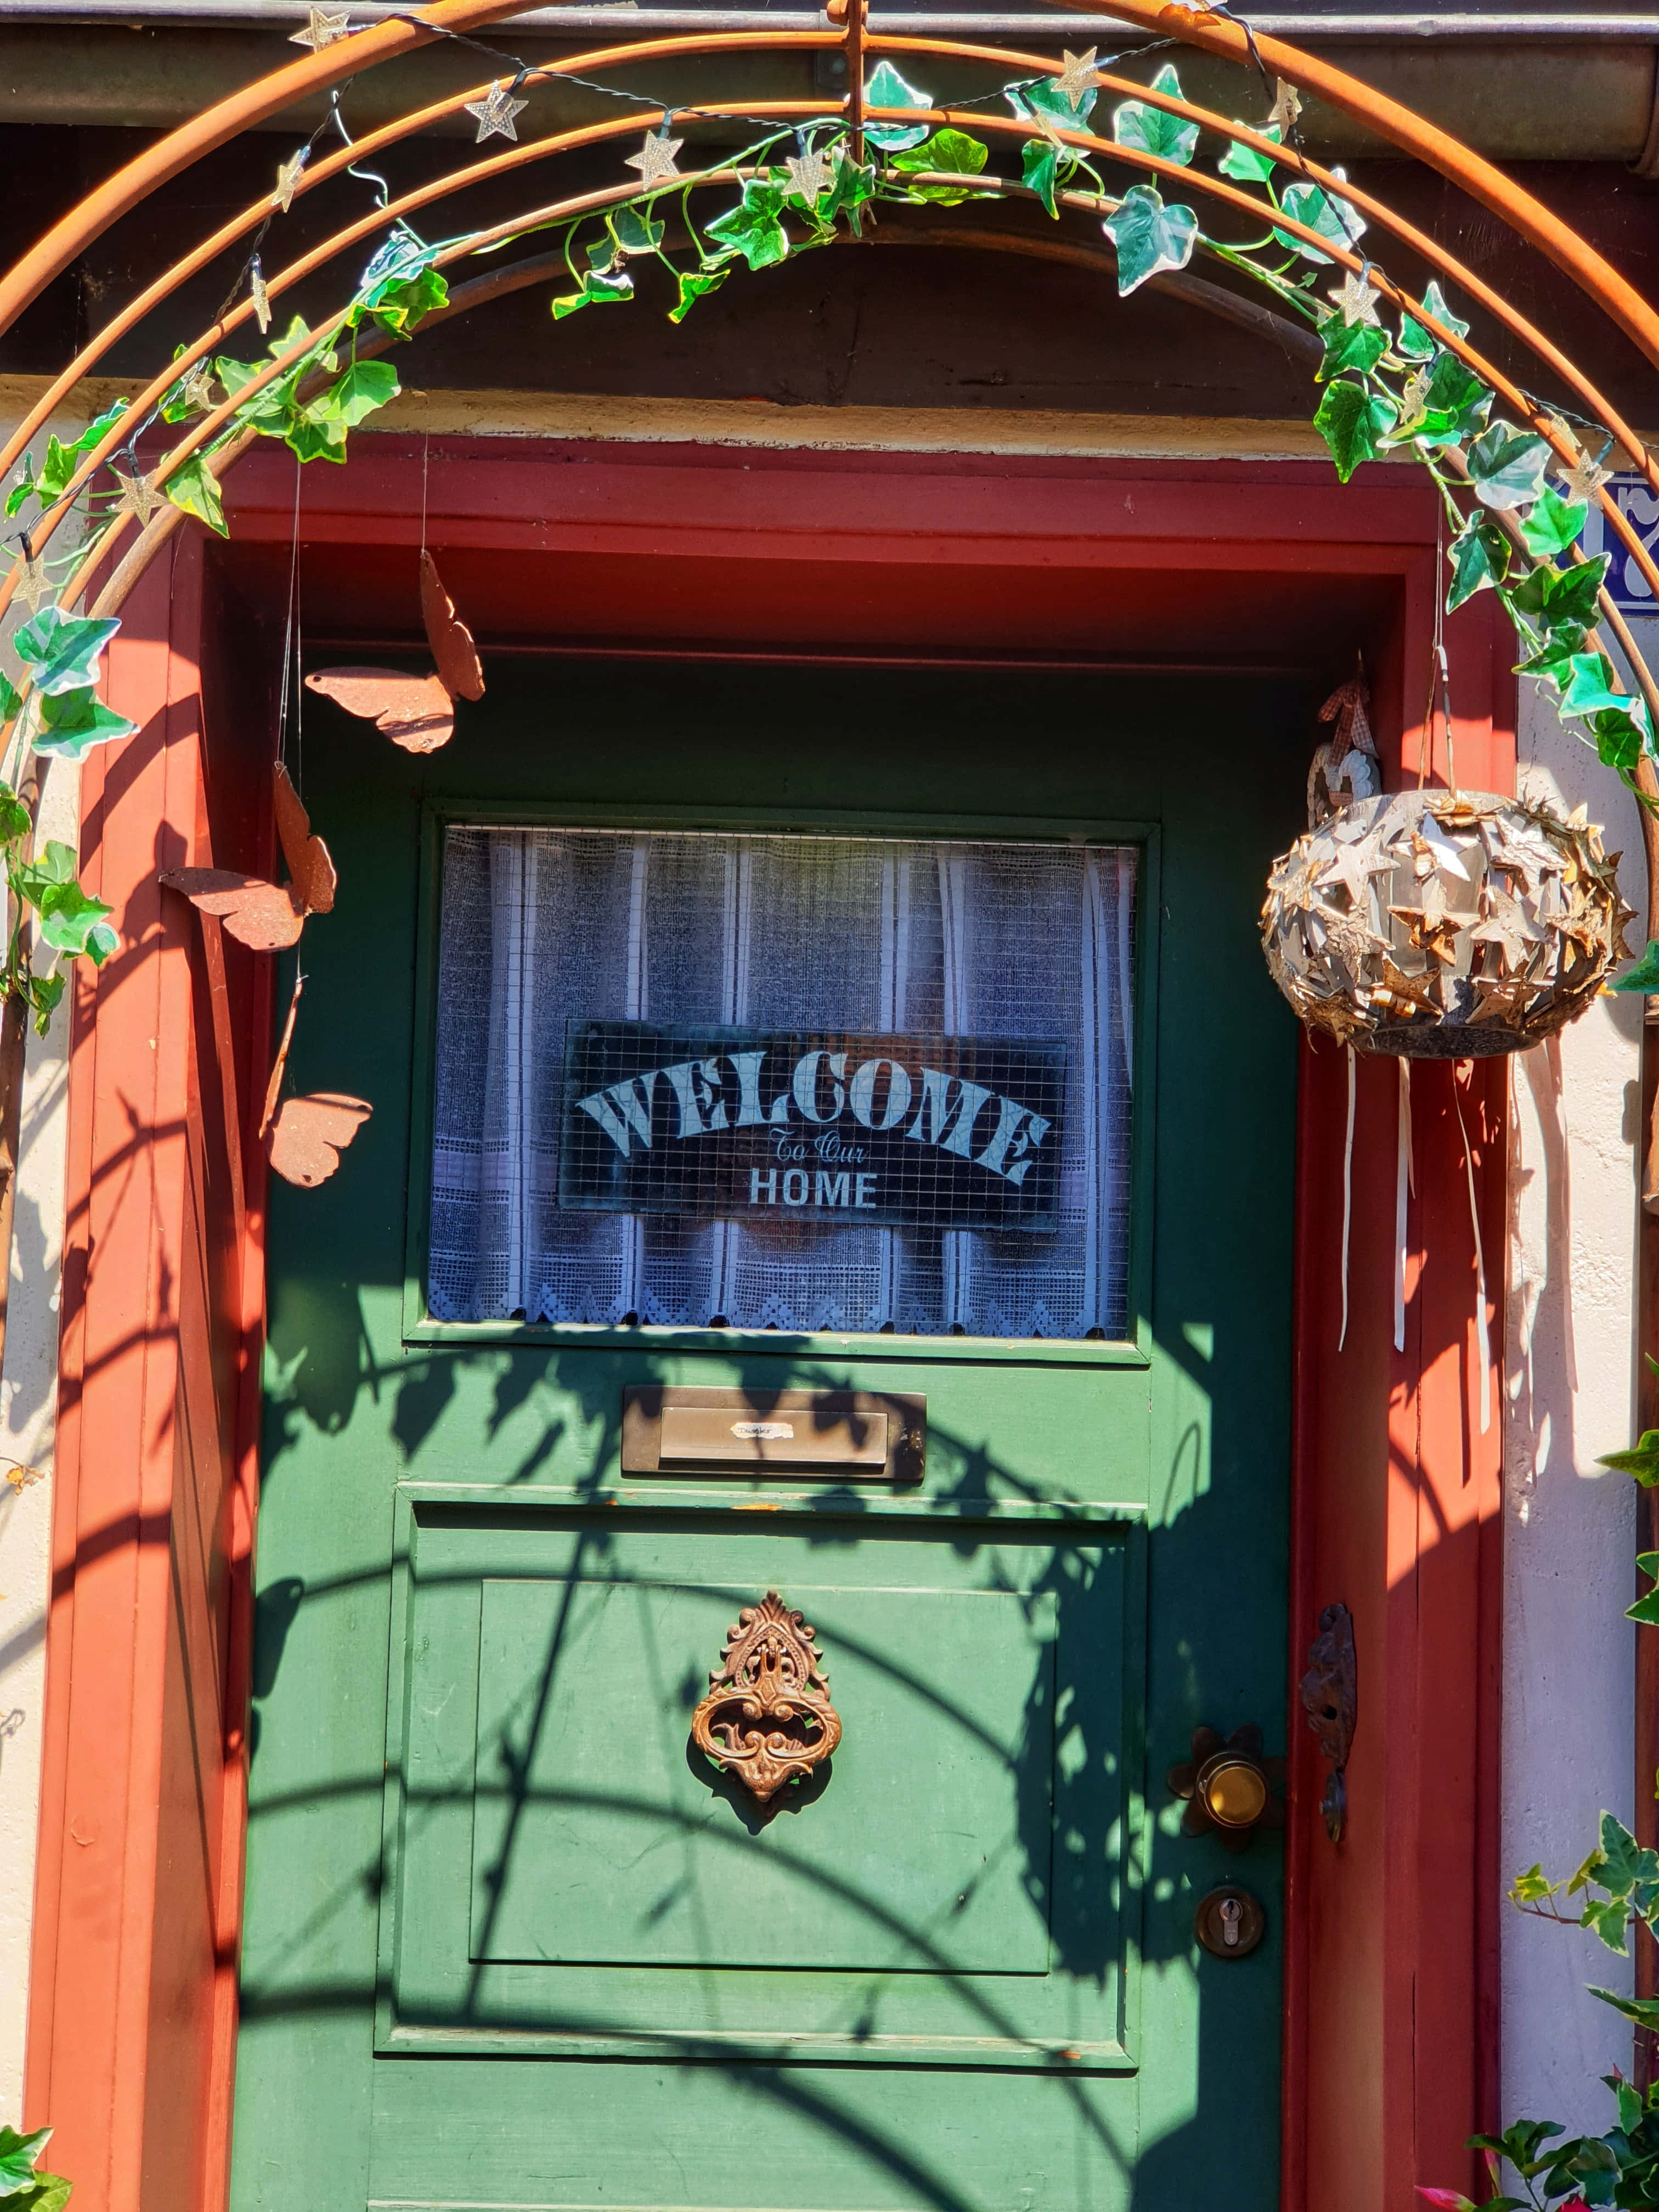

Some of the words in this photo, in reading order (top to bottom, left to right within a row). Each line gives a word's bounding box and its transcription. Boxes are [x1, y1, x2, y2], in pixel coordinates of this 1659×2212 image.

[575, 1050, 1052, 1186] WELCOME
[770, 1127, 809, 1161] To
[814, 1130, 868, 1163] Our
[750, 1167, 878, 1209] HOME
